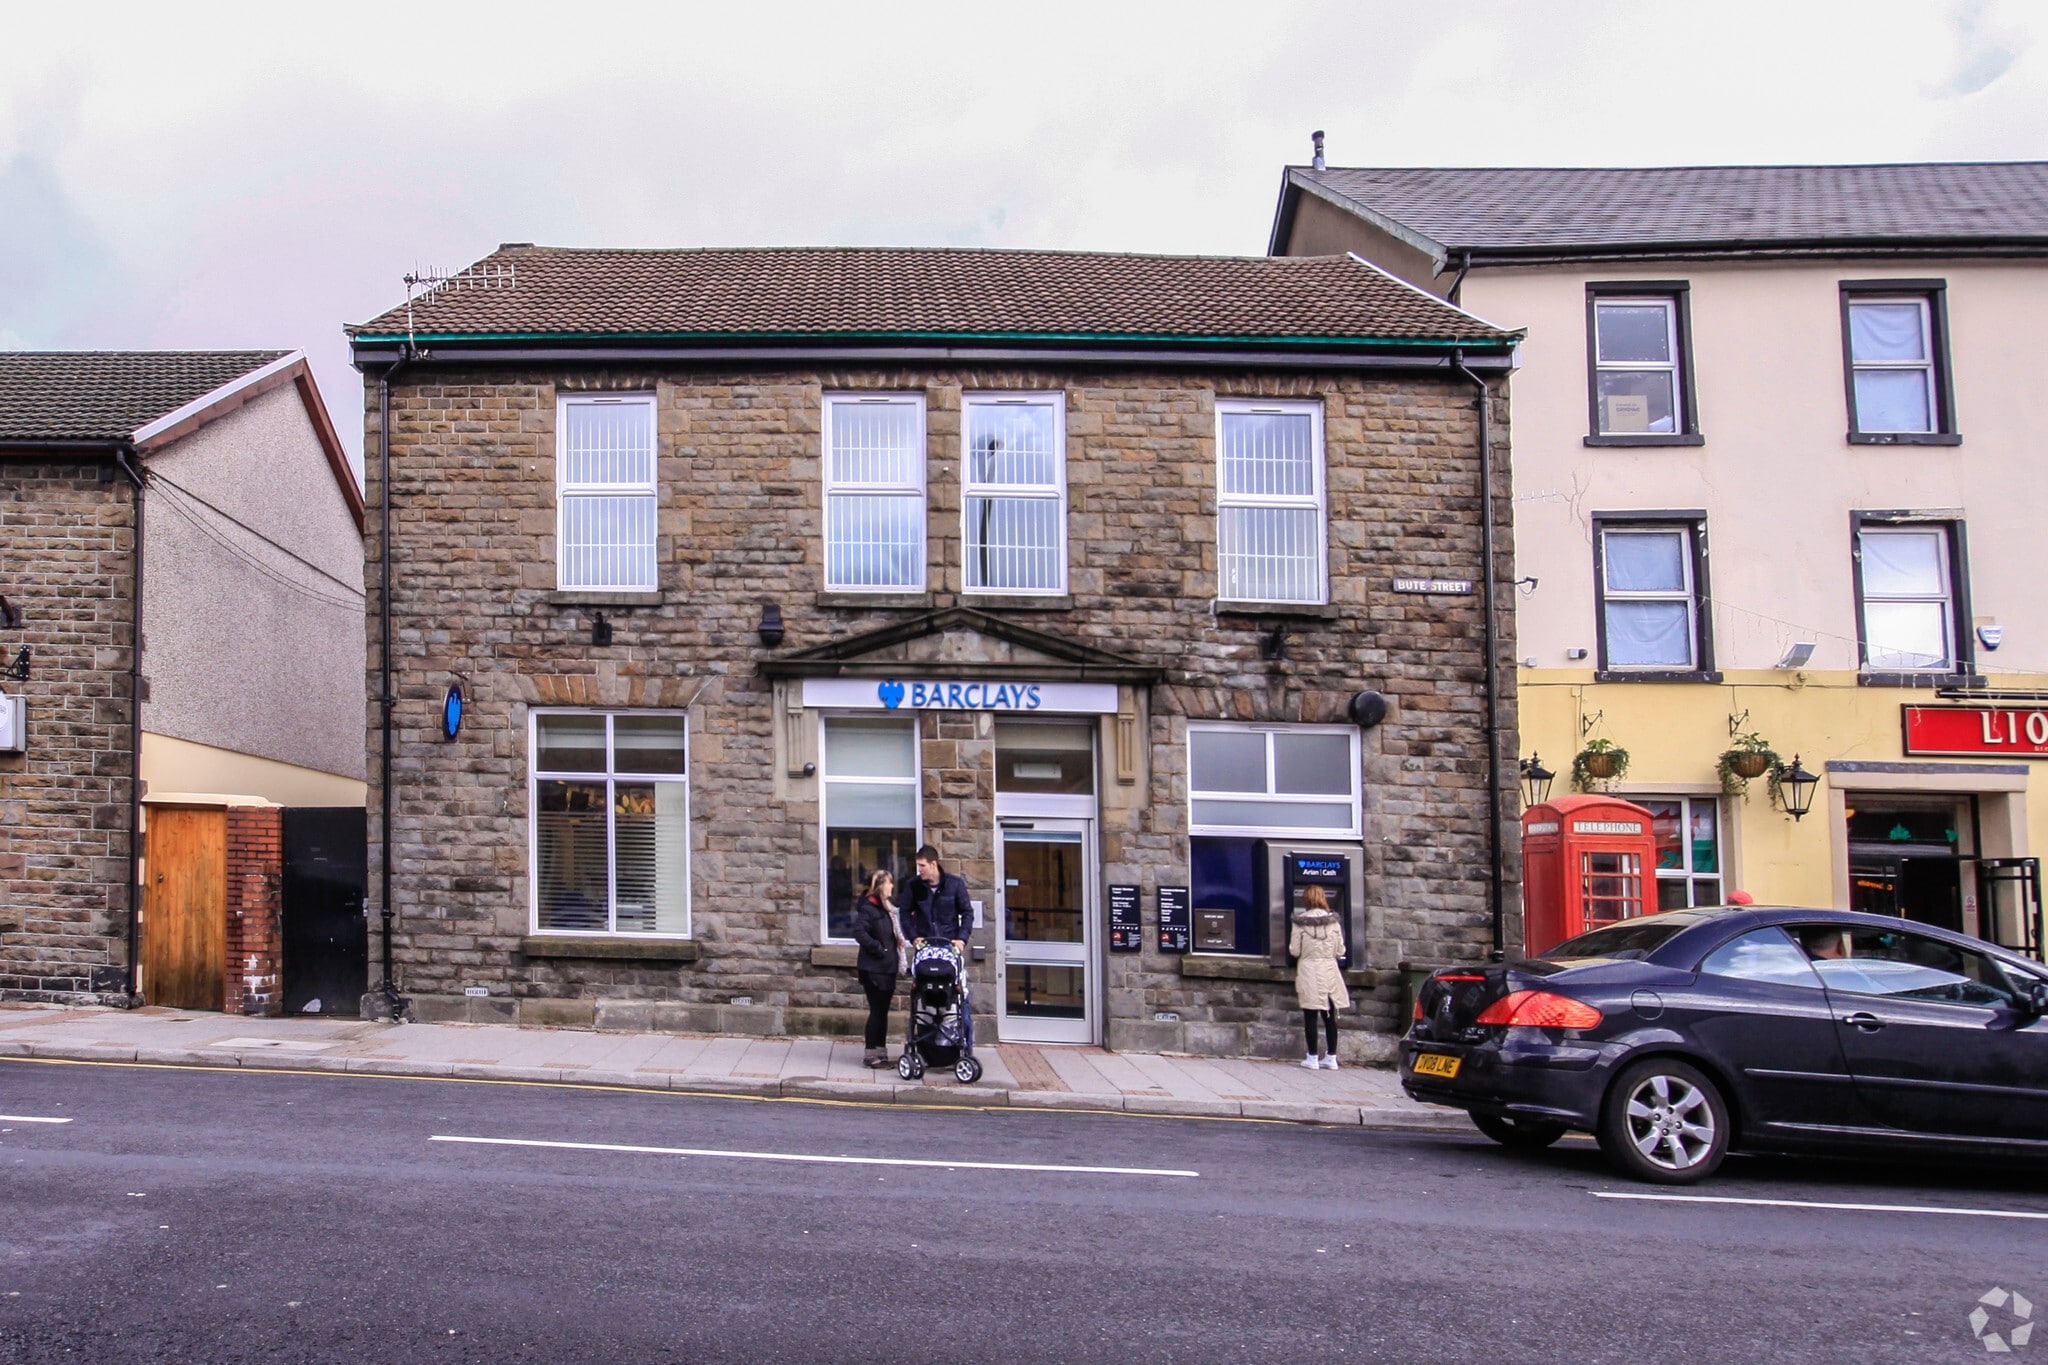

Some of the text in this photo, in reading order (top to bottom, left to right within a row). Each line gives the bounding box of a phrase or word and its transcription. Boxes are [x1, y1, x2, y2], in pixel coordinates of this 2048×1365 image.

[1398, 580, 1467, 592] BUTE STREET
[912, 682, 1041, 709] BARCLAYS
[1576, 822, 1639, 833] TELEPHONE
[1306, 861, 1341, 869] BARCLAYS
